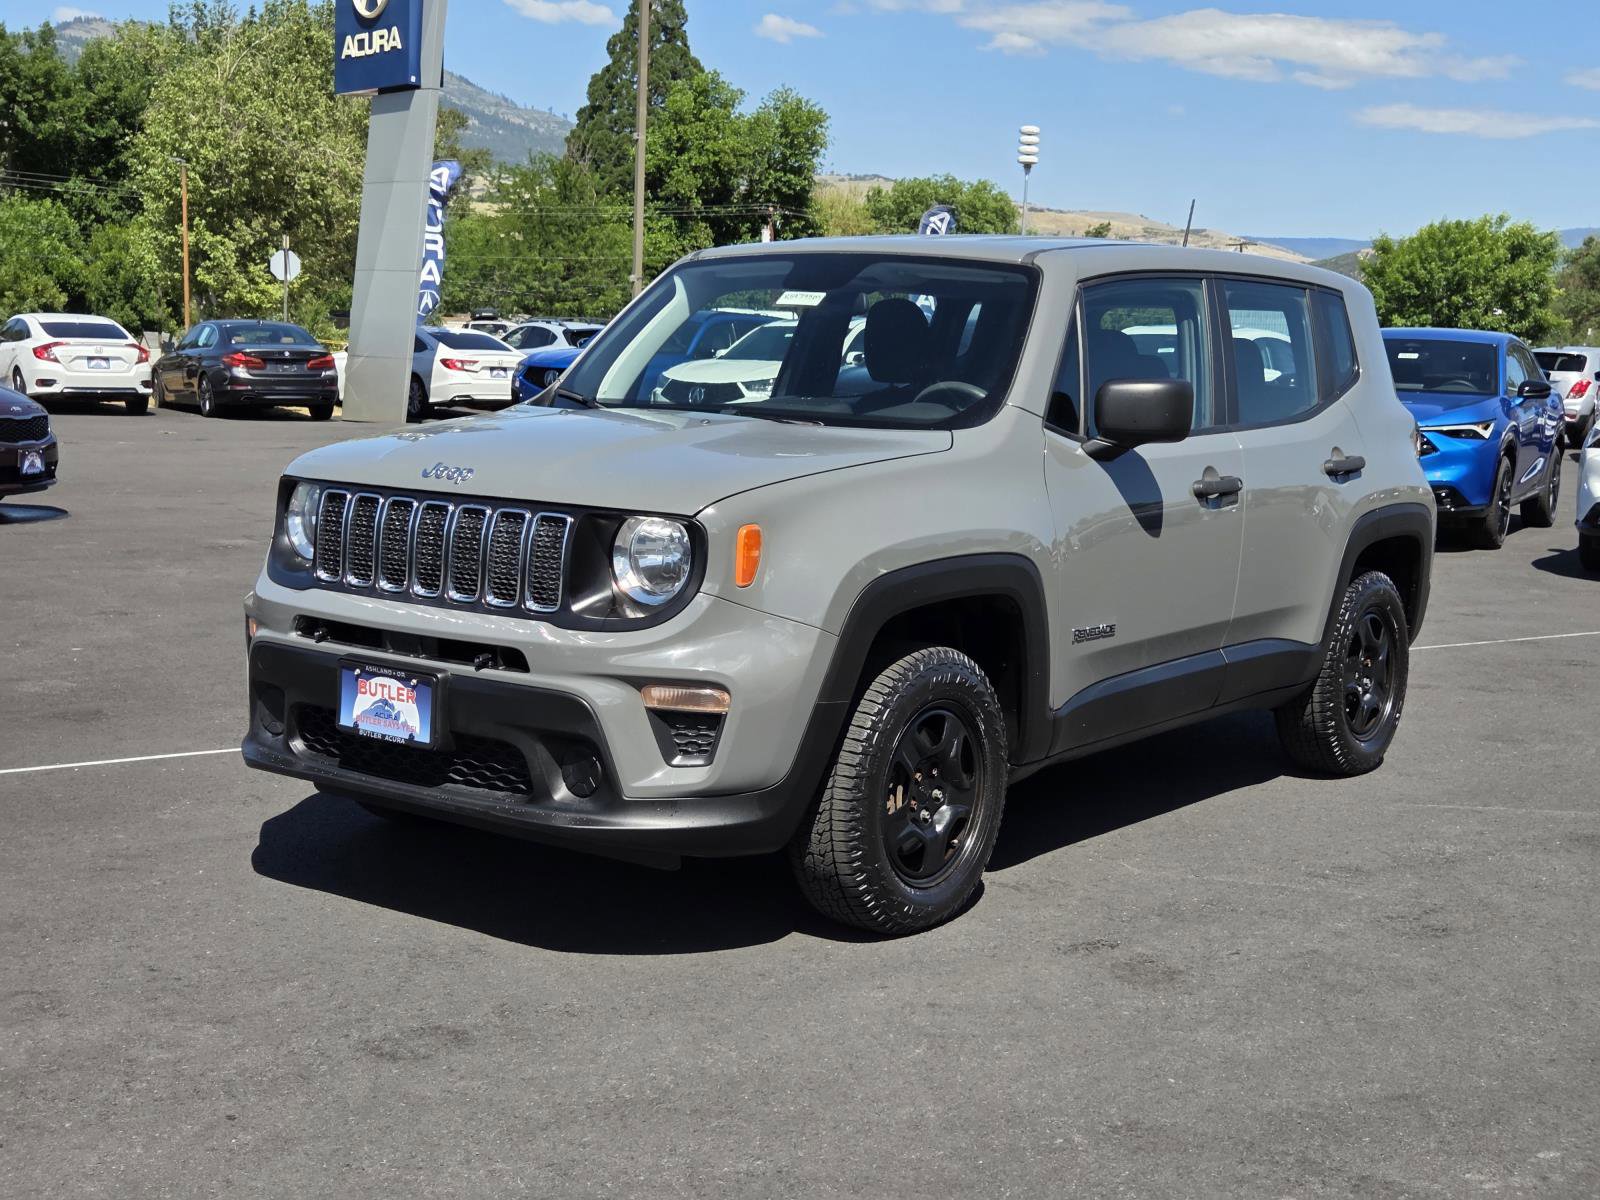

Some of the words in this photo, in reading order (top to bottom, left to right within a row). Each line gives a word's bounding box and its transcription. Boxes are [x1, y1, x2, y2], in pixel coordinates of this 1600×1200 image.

[341, 26, 402, 59] ACURA
[422, 462, 474, 484] Jeep
[1072, 624, 1116, 643] RENEGADE
[365, 665, 393, 676] ASHLAND
[358, 679, 416, 704] BUTLER
[355, 714, 382, 726] BUTLER
[384, 719, 400, 730] SAYS
[374, 711, 398, 721] ACURA
[359, 729, 382, 740] BUTLER
[384, 735, 405, 744] ACURA
